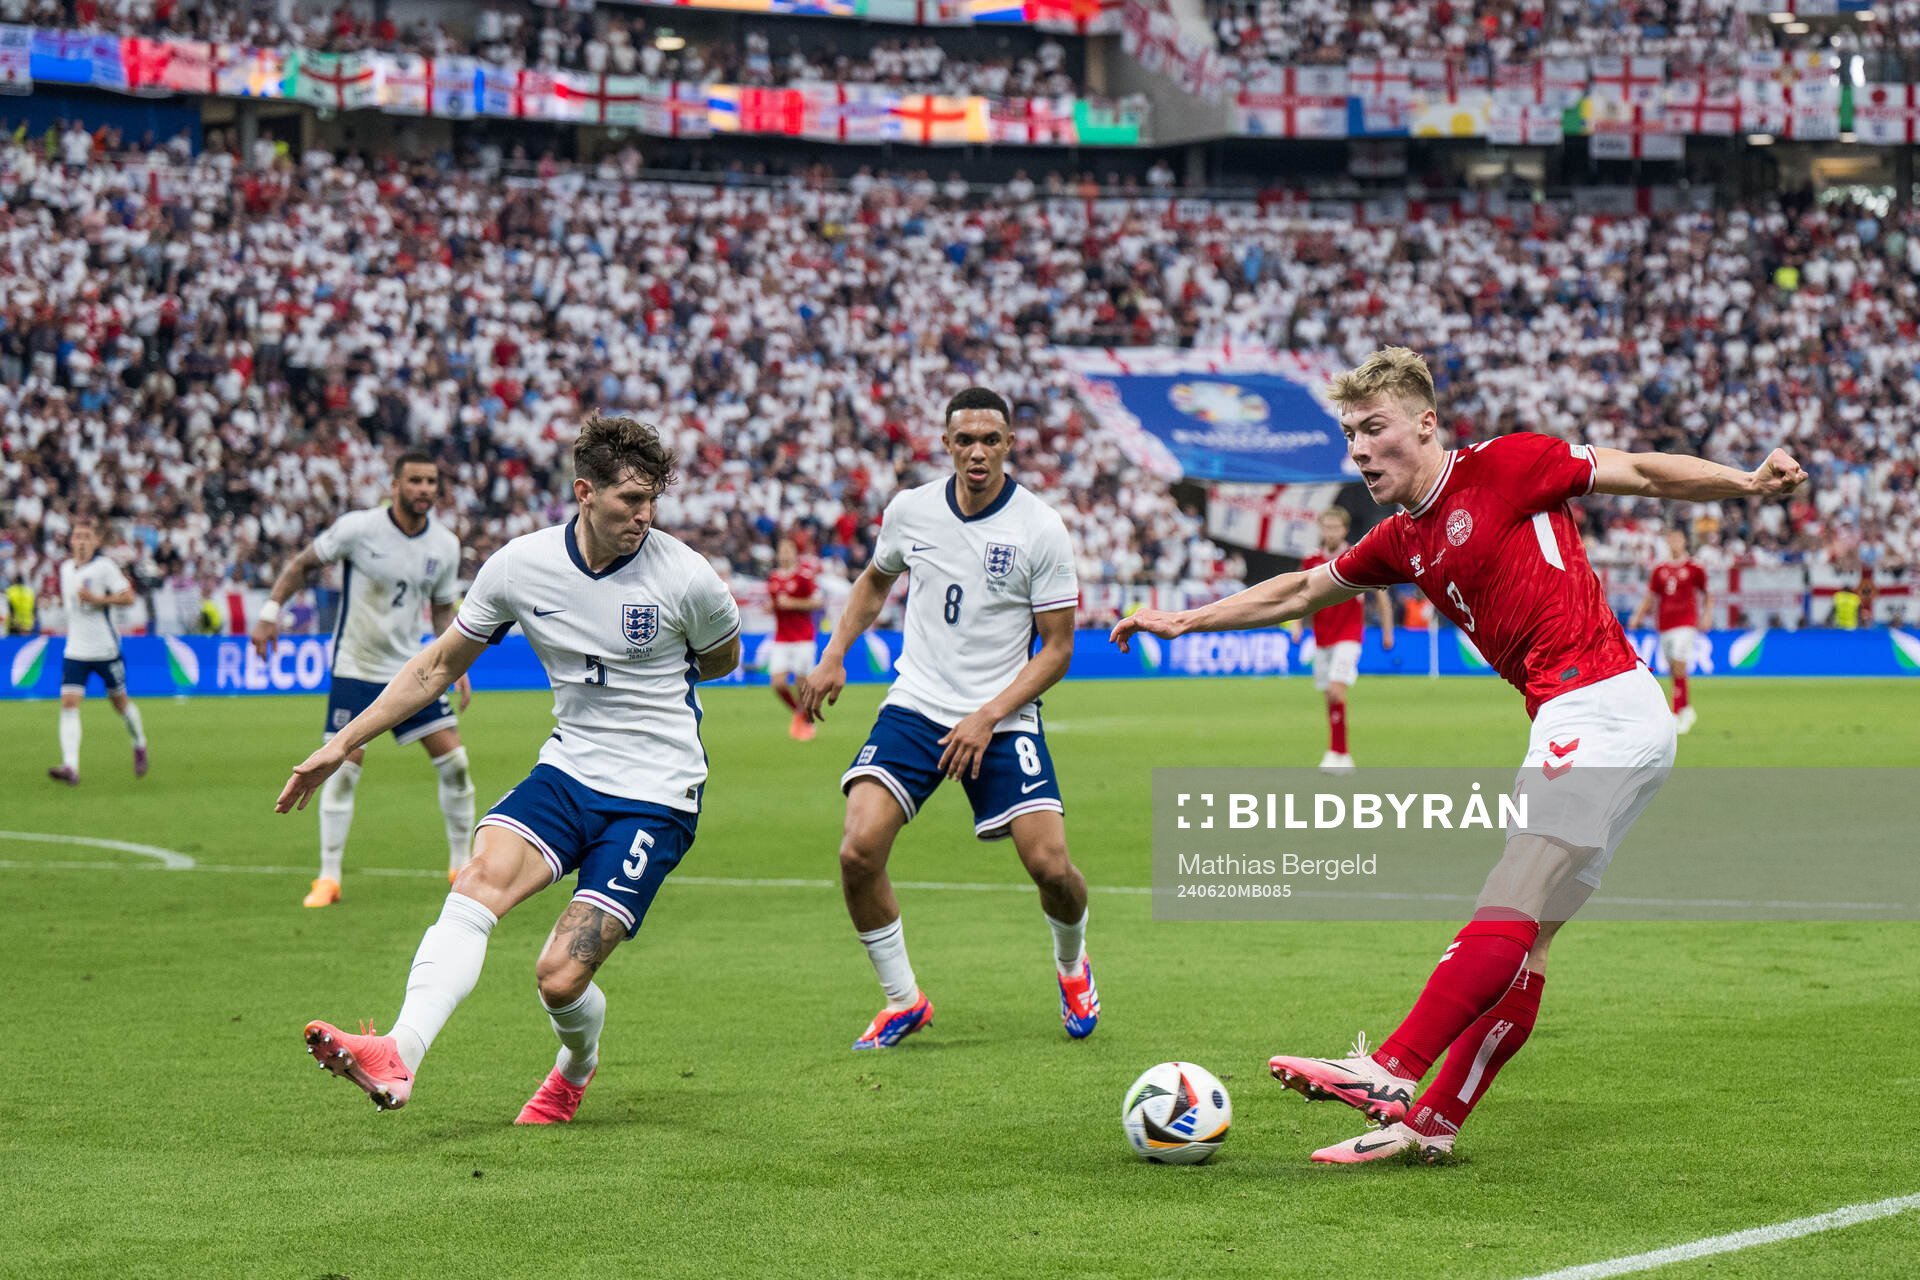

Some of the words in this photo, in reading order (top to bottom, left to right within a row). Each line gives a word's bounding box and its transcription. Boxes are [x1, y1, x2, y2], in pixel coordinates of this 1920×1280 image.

[391, 580, 407, 607] 2
[944, 583, 964, 625] 8
[584, 653, 608, 686] 5
[1014, 735, 1042, 777] 8
[622, 828, 656, 881] 5
